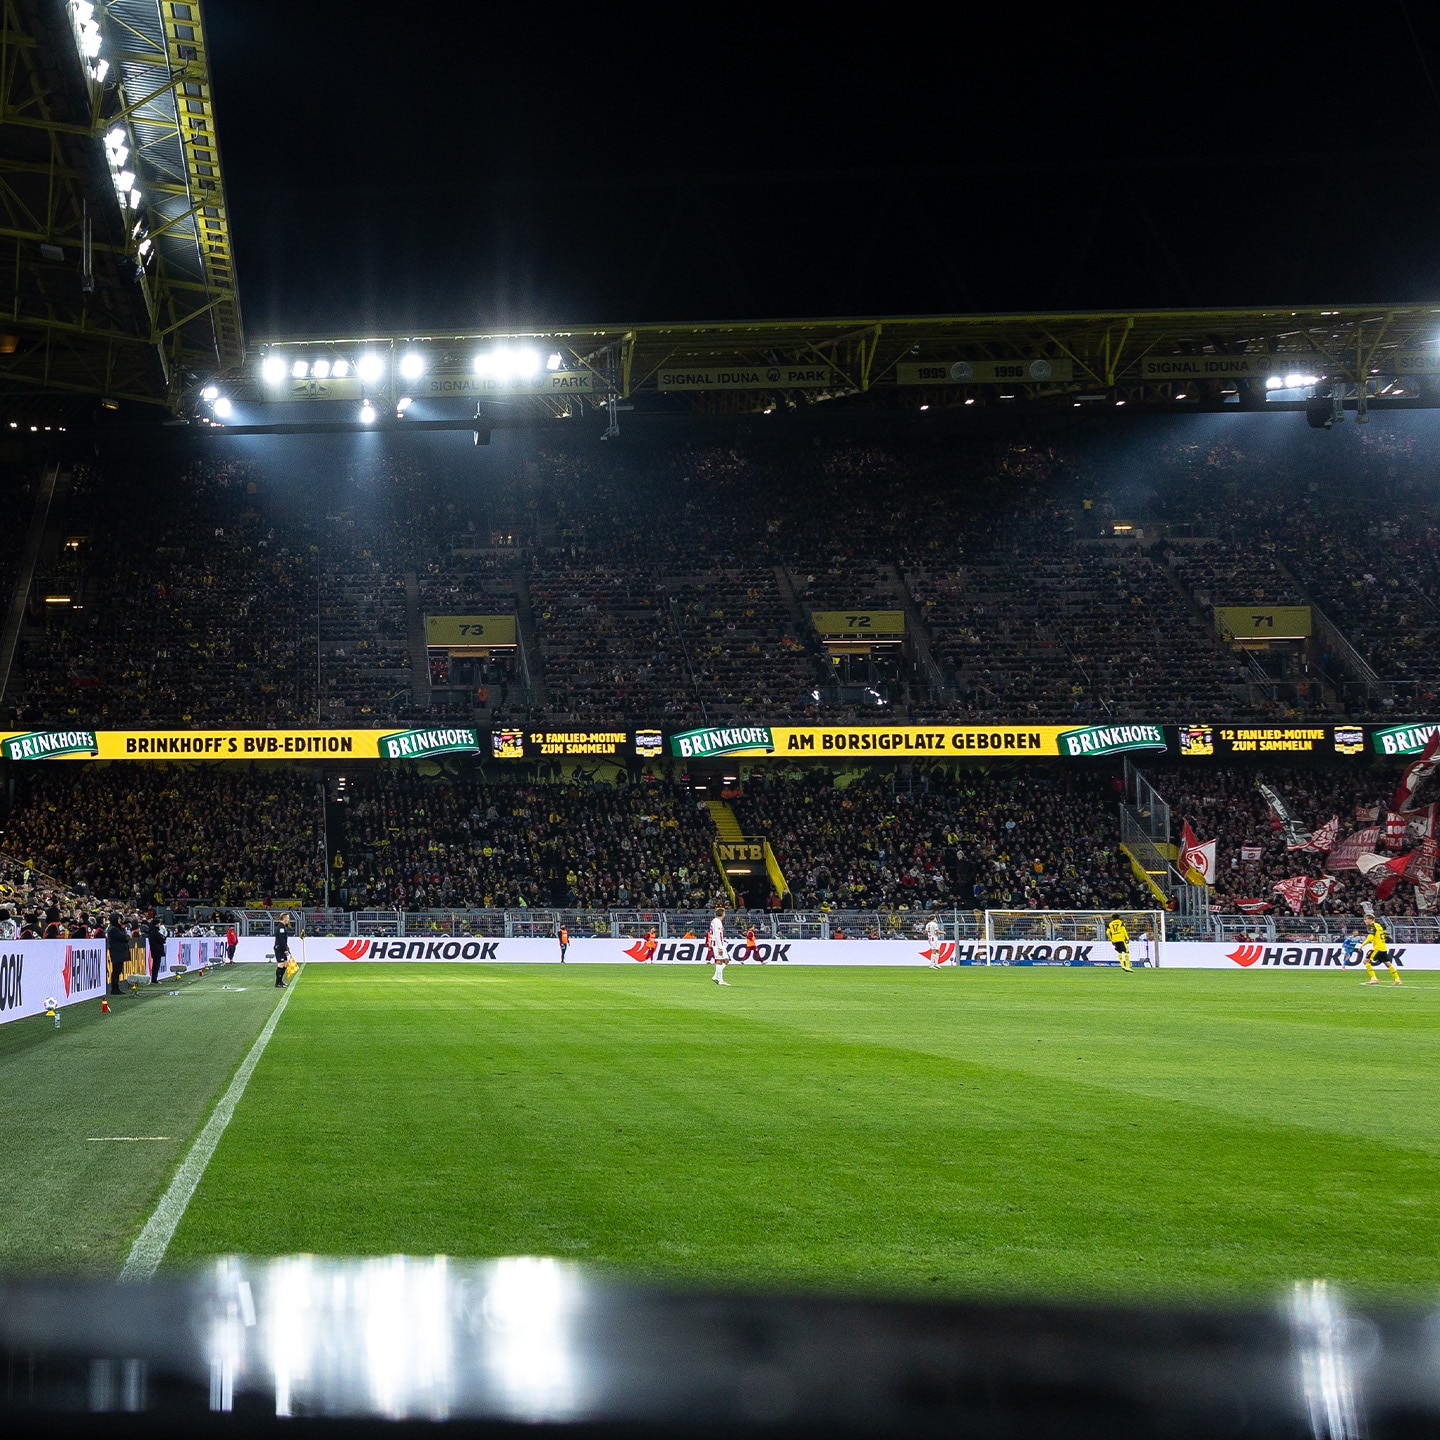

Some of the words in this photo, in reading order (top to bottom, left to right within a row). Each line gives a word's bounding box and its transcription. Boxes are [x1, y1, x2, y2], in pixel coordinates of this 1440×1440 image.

[918, 368, 946, 379] 1995
[995, 366, 1023, 377] 1996
[1148, 362, 1200, 373] SIGNAL
[1205, 361, 1249, 372] IDUNA
[431, 380, 479, 391] SIGNAL
[552, 376, 588, 388] PARK
[663, 374, 712, 385] SIGNAL
[717, 373, 759, 384] IDUNA
[789, 371, 825, 381] PARK
[845, 616, 871, 627] 72
[1251, 615, 1273, 627] 71
[459, 624, 484, 636] 73
[529, 733, 543, 743] 12
[546, 732, 627, 743] FANLIED-MOTIVE
[1220, 730, 1234, 740] 12
[1237, 729, 1325, 740] FANLIED-MOTIVE
[126, 737, 238, 752] BRINKHOFF'S
[244, 737, 352, 752] BVB-EDITION
[787, 734, 814, 750] AM
[822, 733, 946, 750] BORSIGPLATZ
[952, 733, 1041, 749] GEBOREN
[1232, 740, 1256, 751] ZUM
[1260, 740, 1312, 751] SAMMELN
[541, 744, 563, 754] ZUM
[566, 744, 615, 754] SAMMELN
